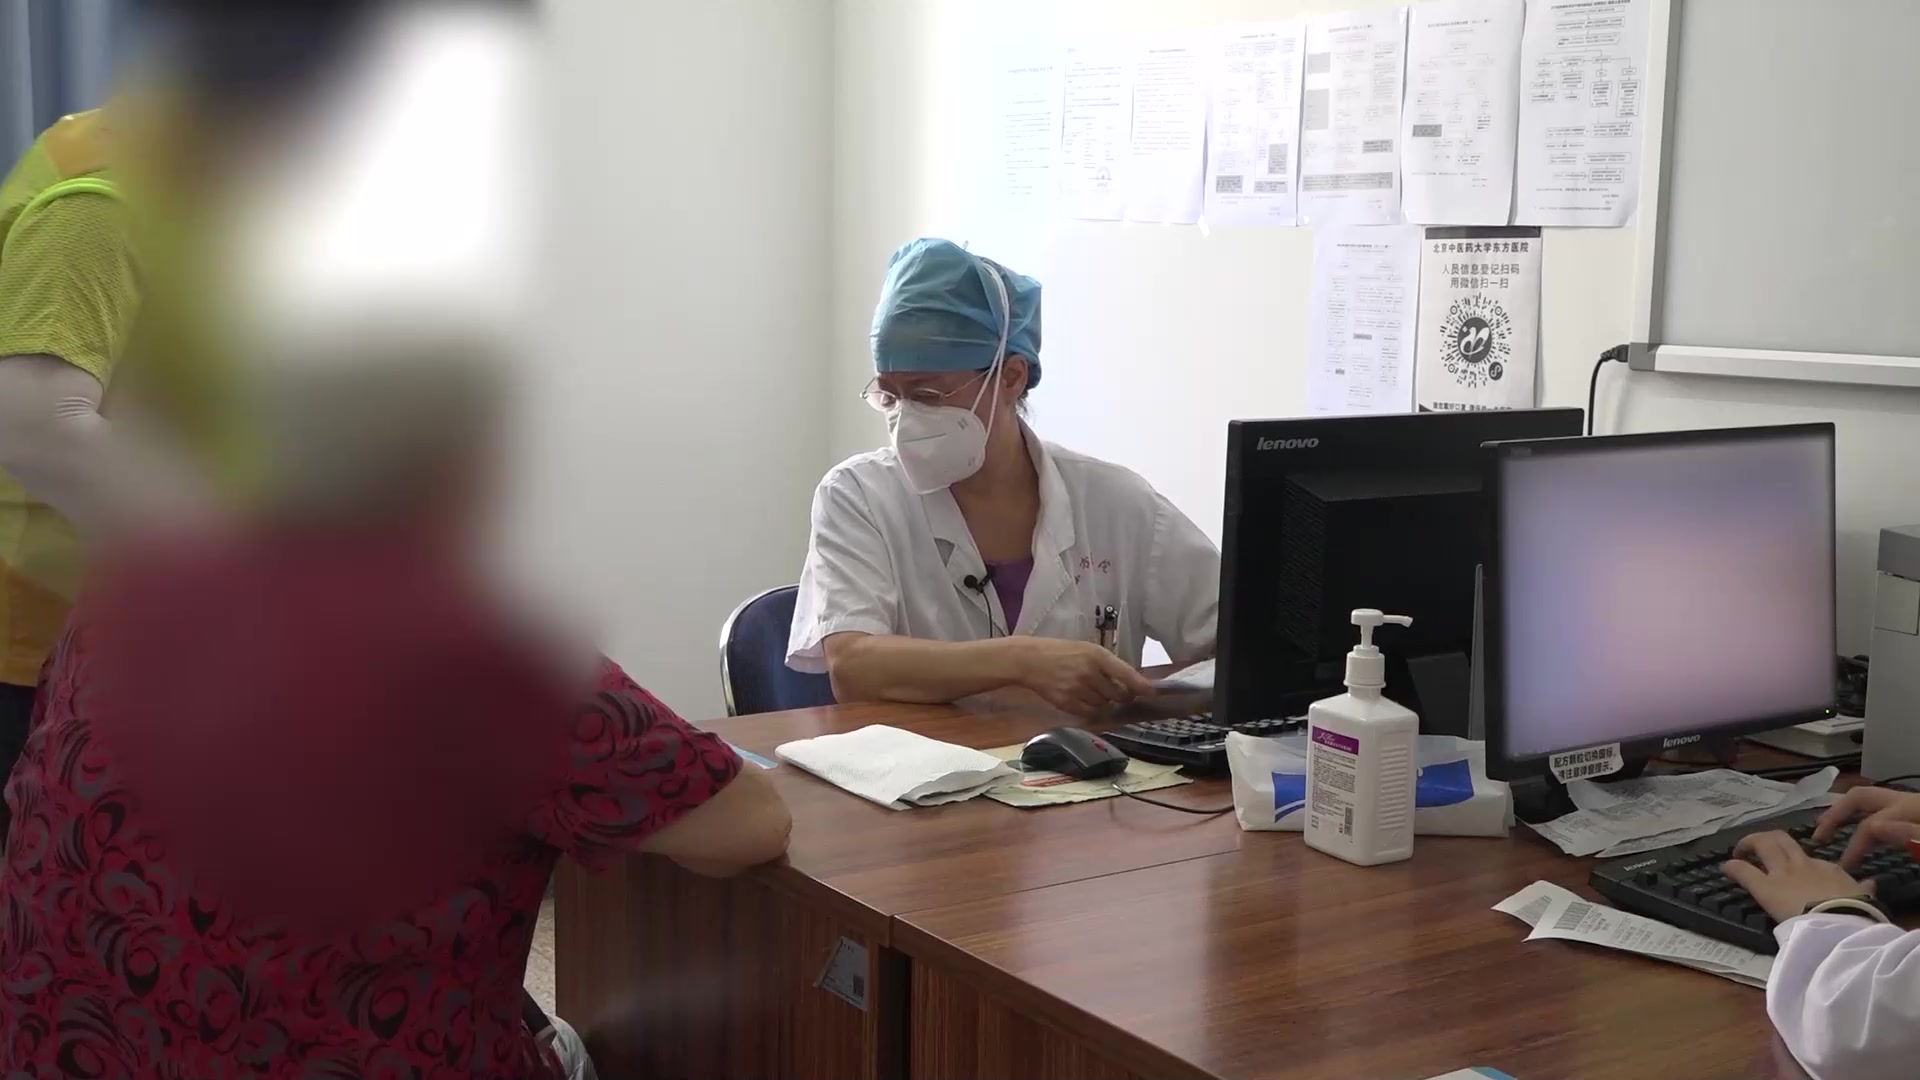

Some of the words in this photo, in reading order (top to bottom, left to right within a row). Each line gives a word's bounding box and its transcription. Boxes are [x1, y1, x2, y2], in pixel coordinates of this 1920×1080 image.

[1433, 242, 1529, 253] 北京中医药大学东方医院
[1442, 263, 1520, 275] 人员信息登记扫码
[1450, 277, 1509, 289] 用微信扫一扫
[1257, 436, 1320, 451] lenovo
[1663, 734, 1701, 749] lenovo
